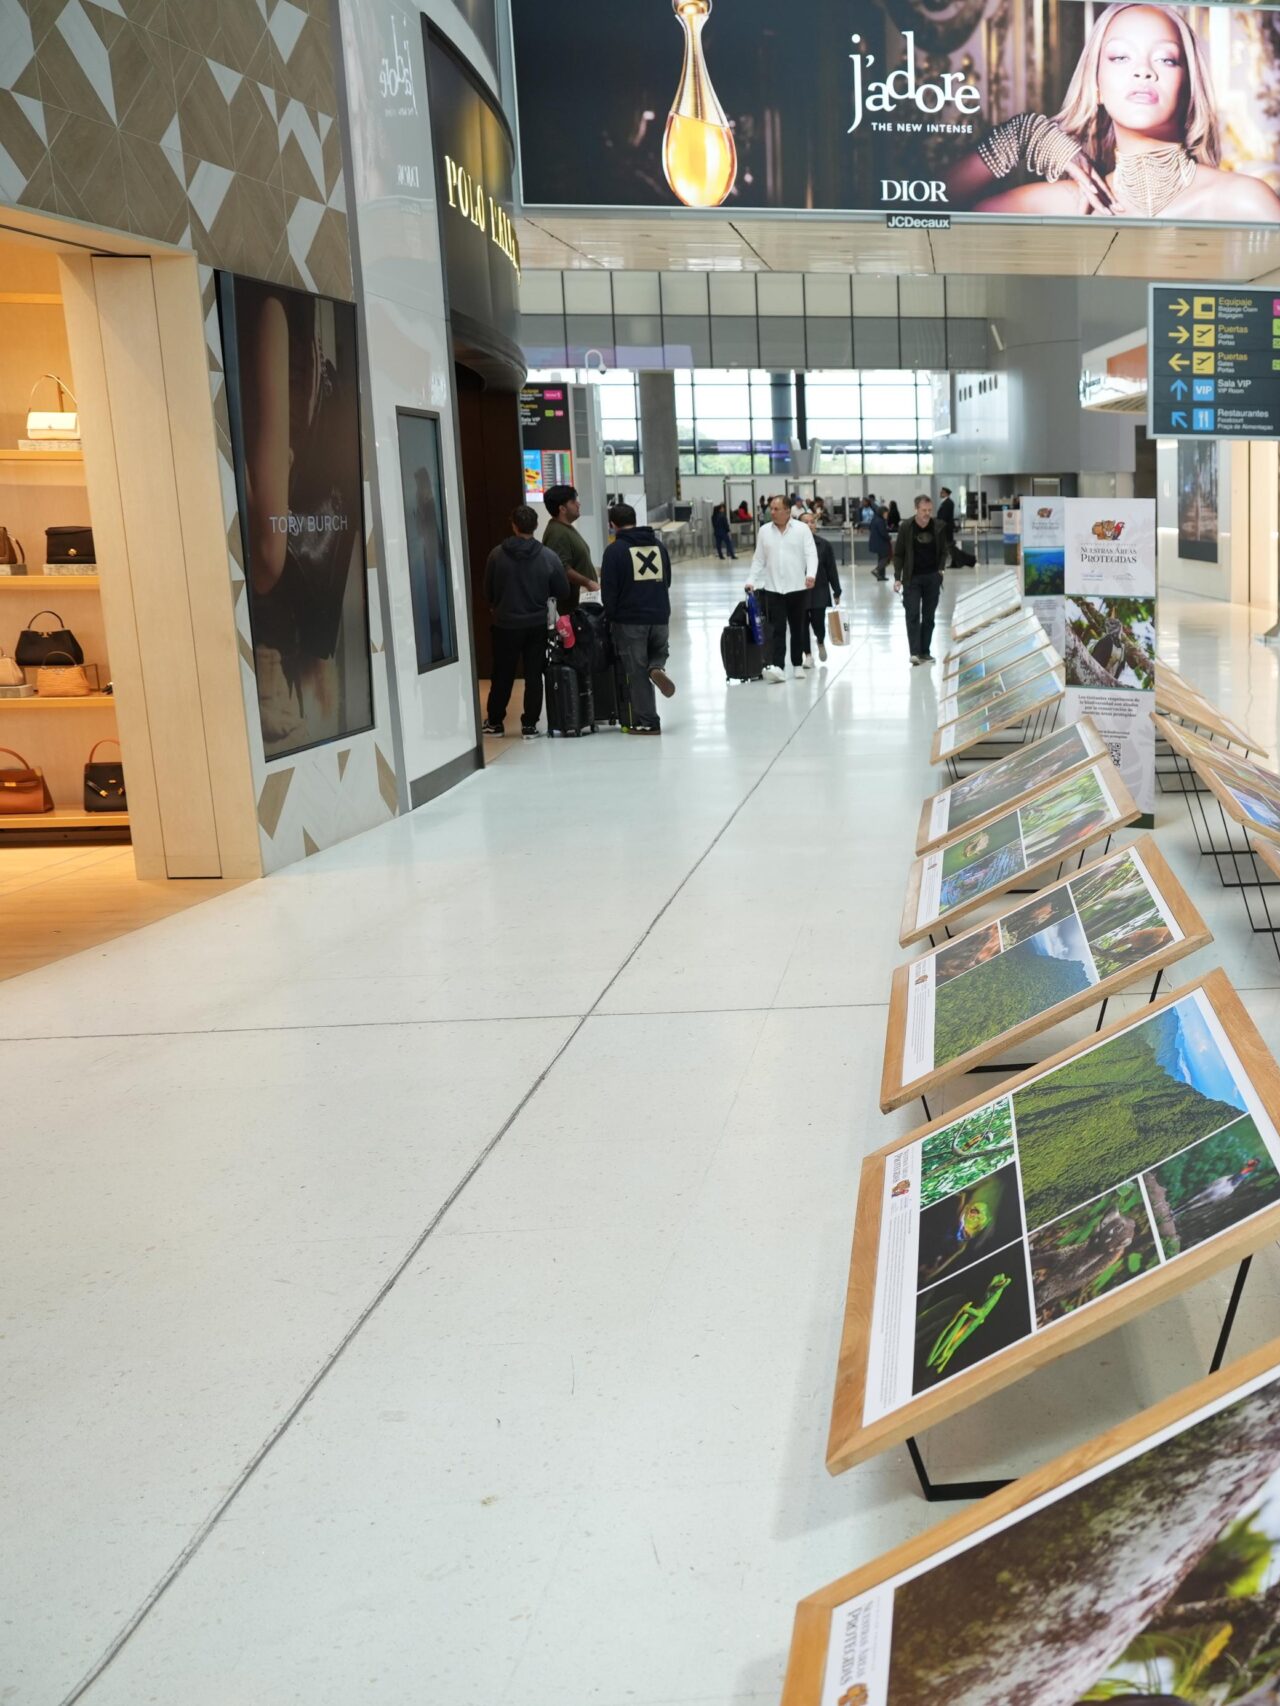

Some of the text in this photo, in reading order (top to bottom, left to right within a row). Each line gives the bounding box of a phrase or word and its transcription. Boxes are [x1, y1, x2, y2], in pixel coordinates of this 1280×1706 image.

[847, 30, 981, 134] j'adore
[871, 122, 973, 134] THE NEW INTENSE
[444, 155, 485, 232] POLO
[880, 180, 949, 202] DIOR
[887, 216, 950, 228] JCDecaux
[1218, 297, 1252, 306] Equipaje
[1218, 325, 1248, 333] Puertas
[1218, 352, 1248, 361] Puertas
[1218, 379, 1251, 388] Sala VIP
[1195, 386, 1212, 394] VIP
[1218, 409, 1269, 418] Restaurantes
[269, 515, 348, 534] TORY BURCH
[1081, 554, 1137, 563] PROTEGIDAS
